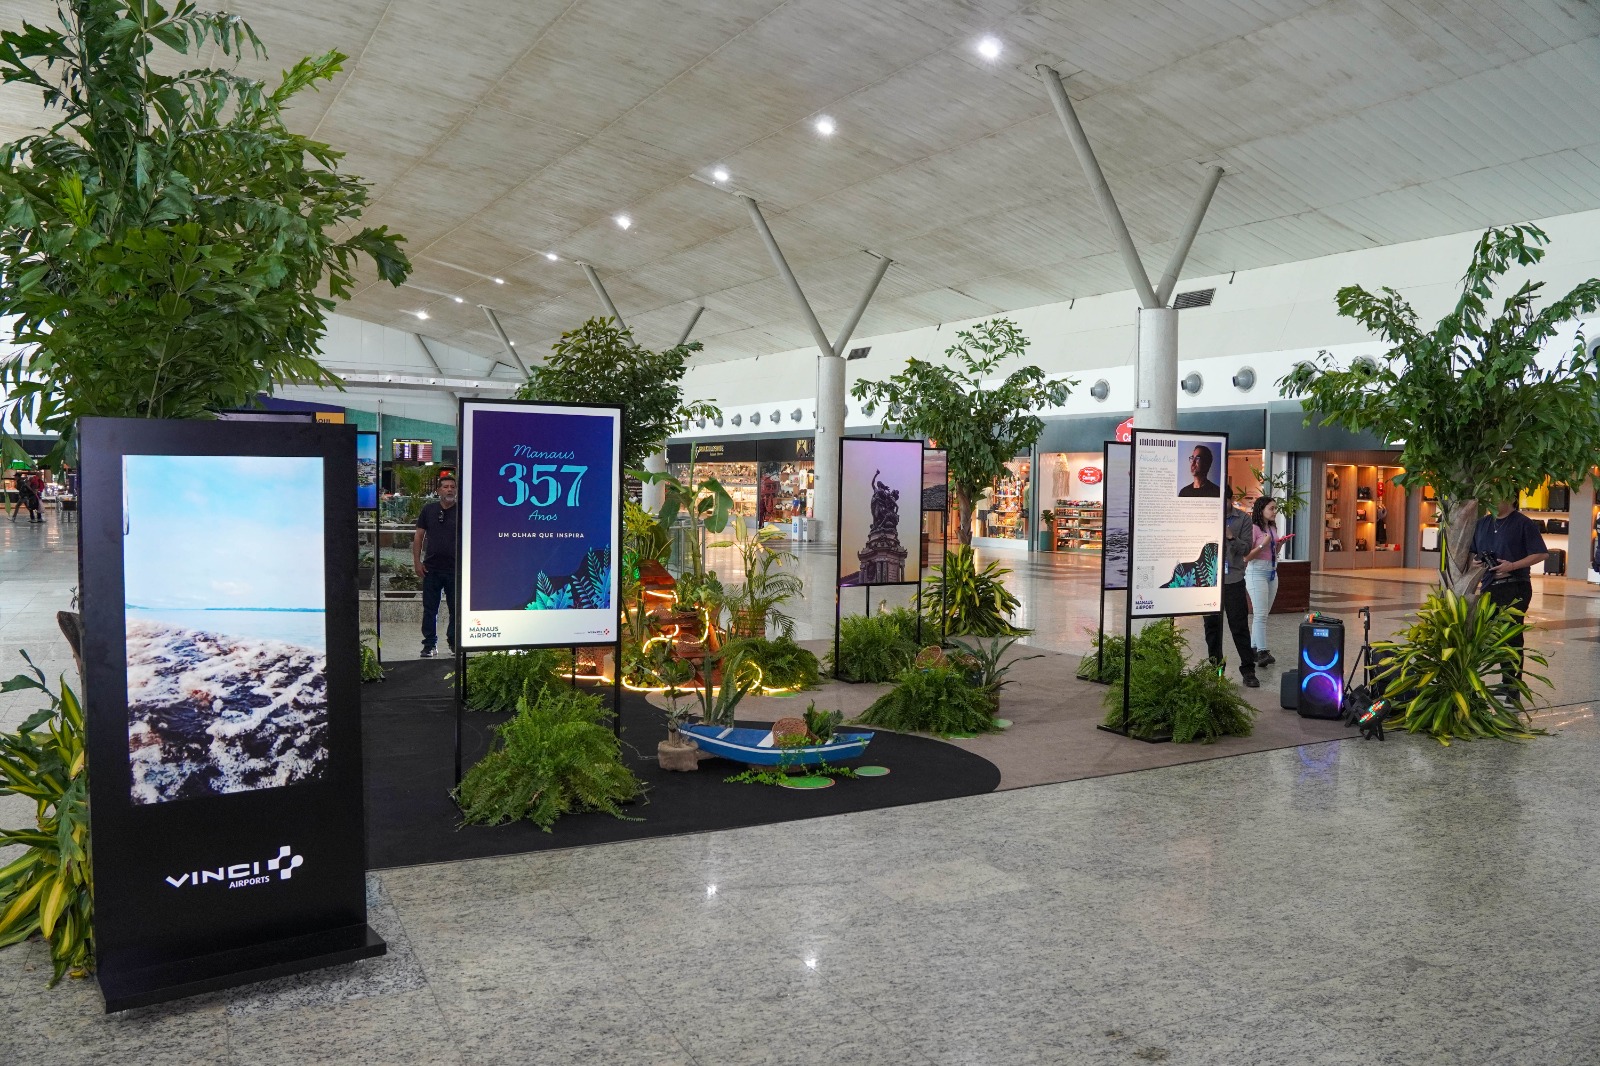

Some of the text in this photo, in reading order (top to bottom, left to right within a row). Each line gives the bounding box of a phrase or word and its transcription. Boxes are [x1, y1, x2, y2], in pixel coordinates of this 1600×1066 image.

[513, 444, 575, 460] Manaus
[497, 462, 589, 507] 357
[528, 509, 558, 521] Anos
[556, 532, 585, 540] INSPIRA
[165, 861, 260, 888] VINCI
[228, 875, 271, 889] AIRPORTS
